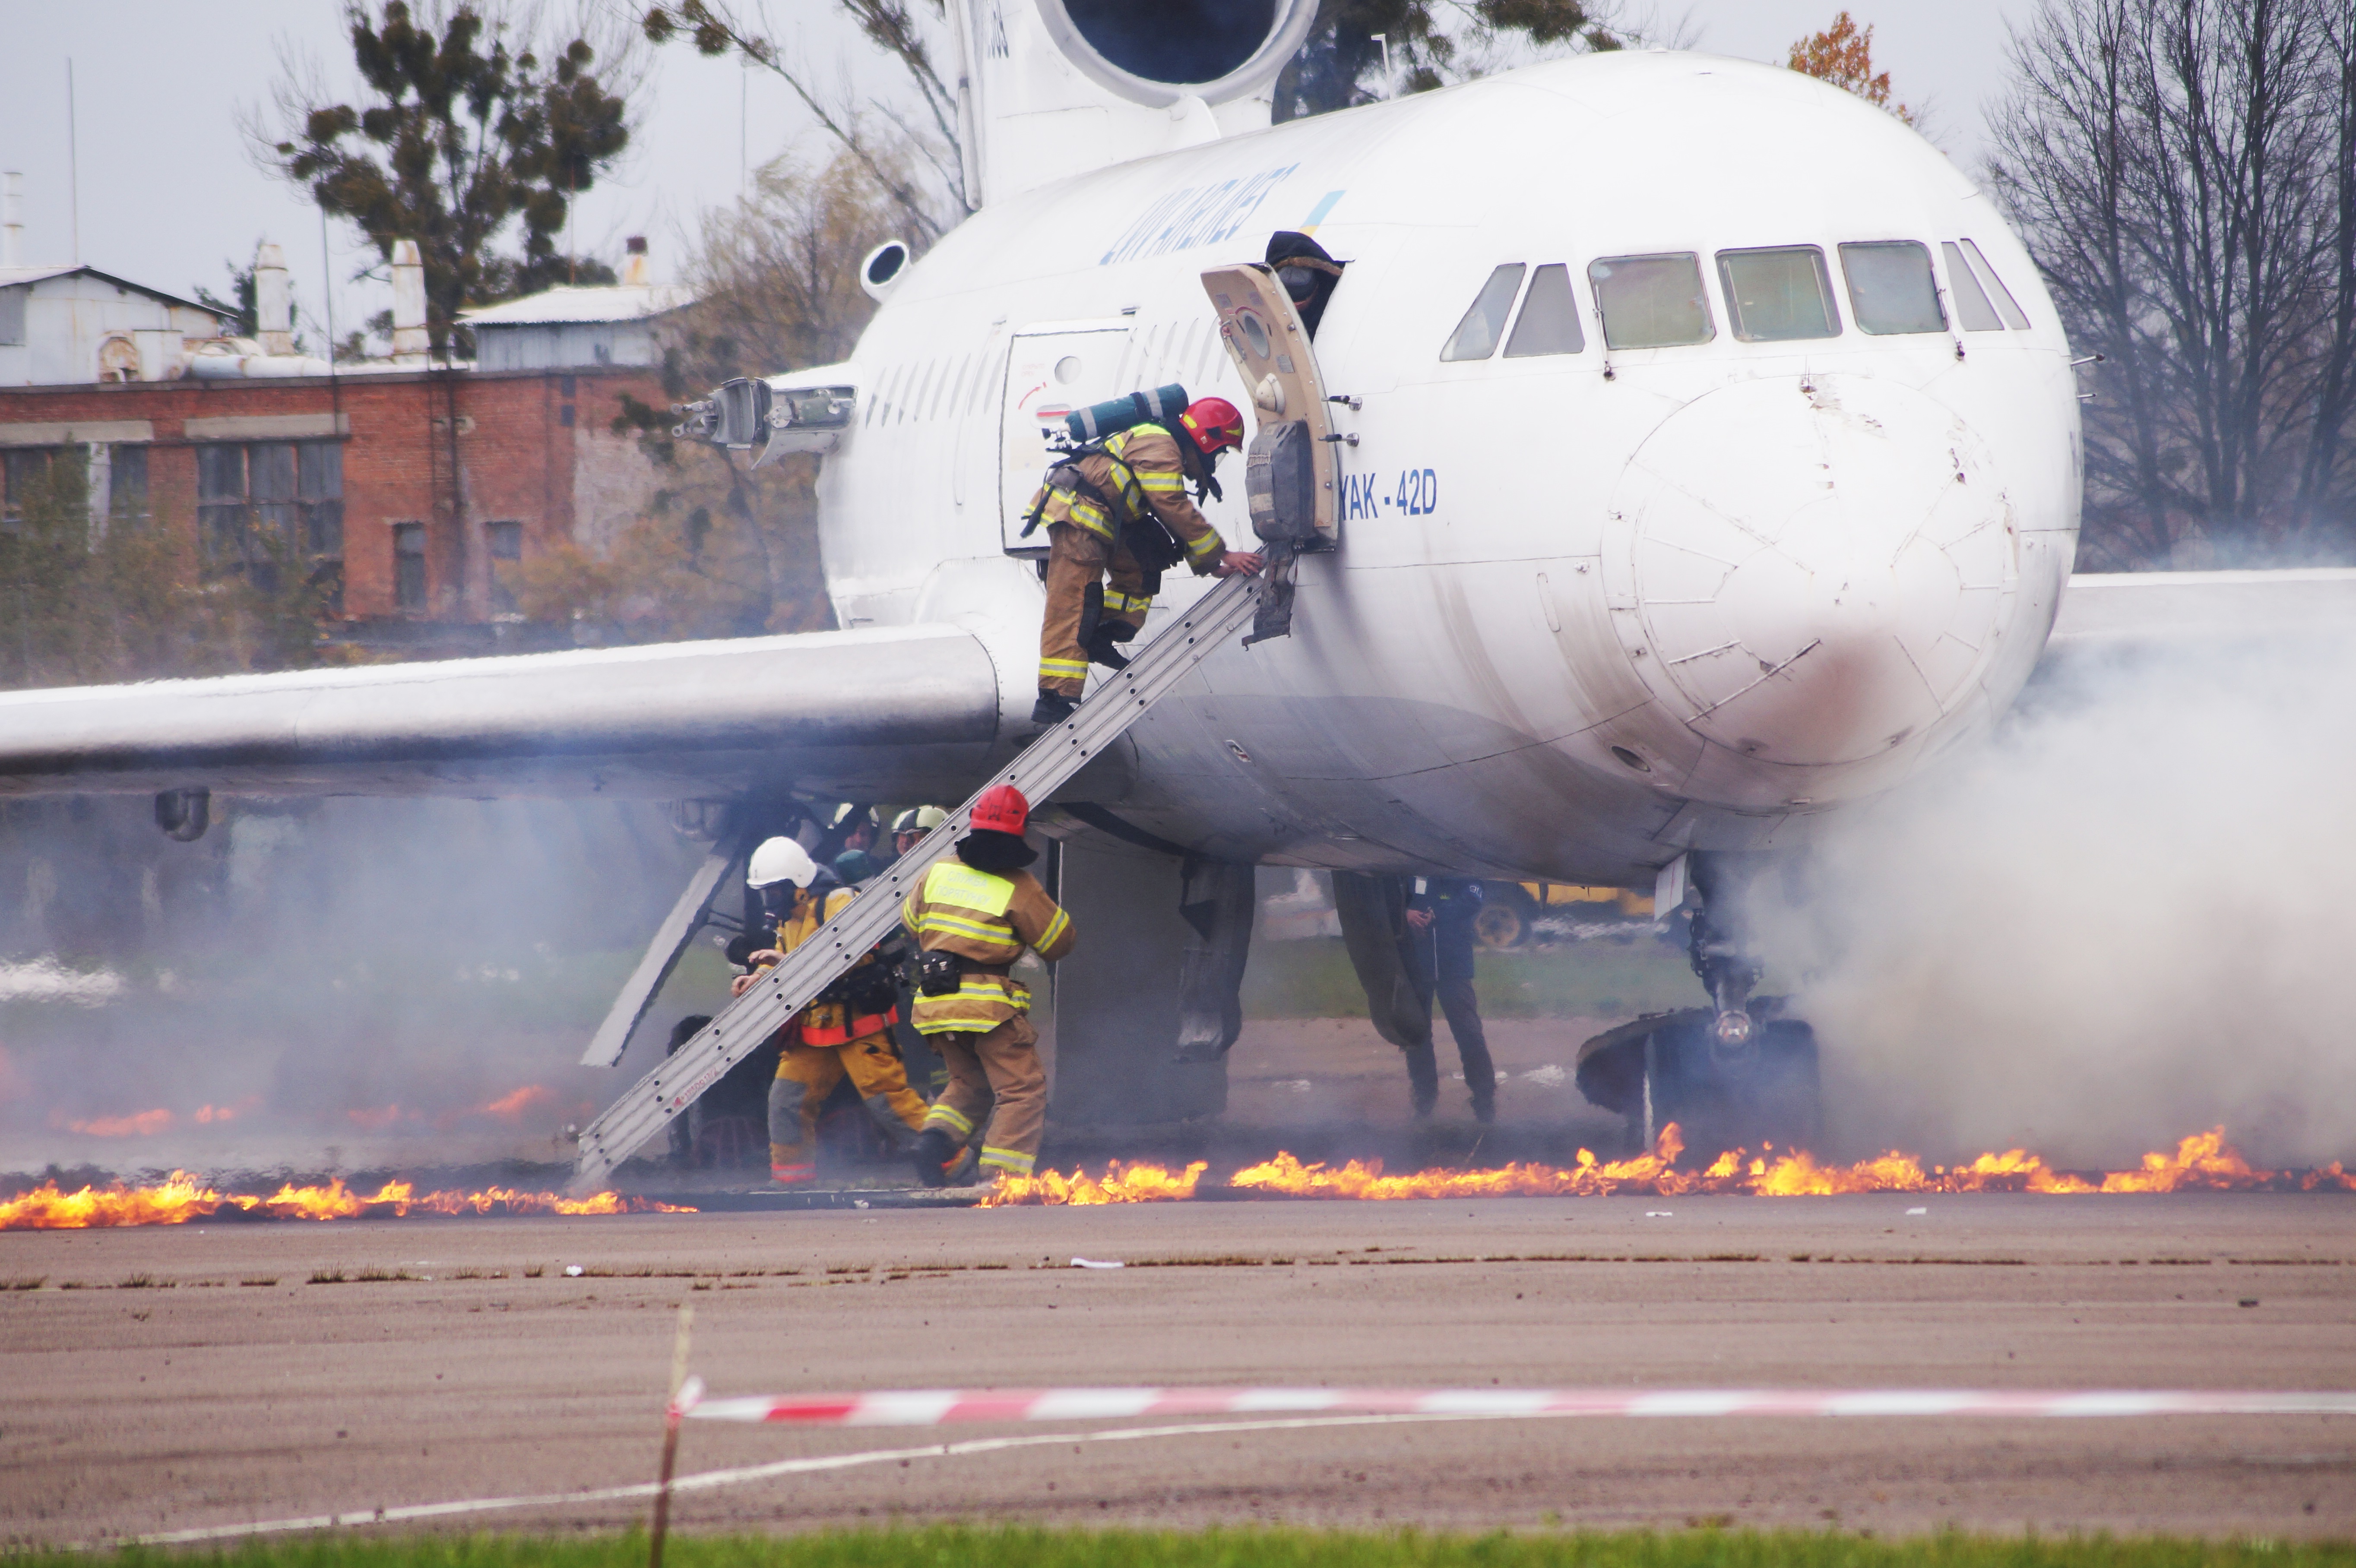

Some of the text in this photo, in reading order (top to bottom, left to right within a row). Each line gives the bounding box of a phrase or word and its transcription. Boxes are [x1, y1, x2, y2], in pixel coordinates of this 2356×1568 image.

[1143, 162, 1301, 258] AIRLINES
[1396, 469, 1437, 516] 42D
[935, 886, 991, 905] ПОРЯТУНКУ
[947, 871, 988, 888] СЛУЖБА
